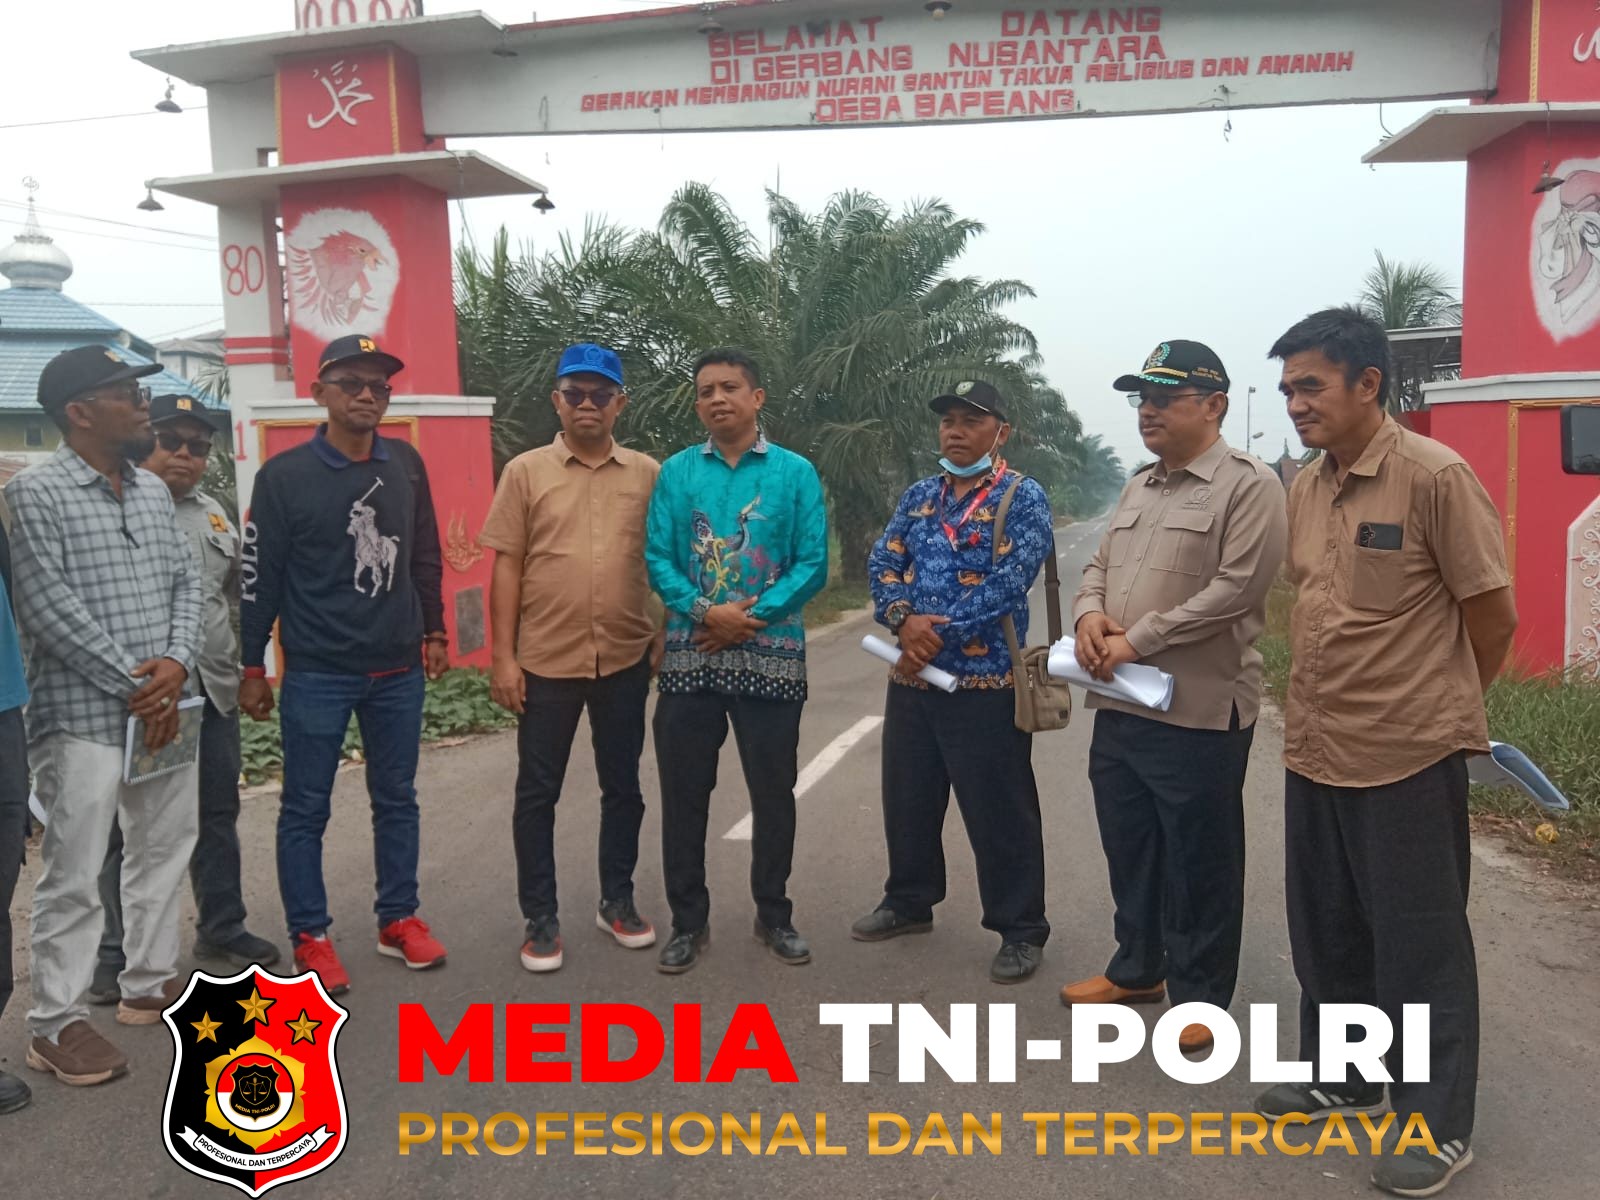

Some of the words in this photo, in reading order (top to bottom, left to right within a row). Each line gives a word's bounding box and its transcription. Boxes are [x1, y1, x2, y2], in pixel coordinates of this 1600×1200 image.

[708, 15, 883, 58] SELAMAT
[1002, 7, 1162, 37] DATANG
[581, 89, 678, 112] GERAKAN
[684, 80, 810, 105] MEMBANGUN
[816, 75, 896, 97] NURANI
[903, 69, 992, 91] SANTUN
[1085, 59, 1194, 82] RELIGIUS
[1201, 56, 1249, 77] DAN
[1257, 51, 1353, 75] AMANAH
[710, 59, 740, 84] DI
[753, 45, 913, 81] GERBANG
[948, 35, 1166, 67] NUSANTARA
[815, 95, 902, 122] DESA
[223, 244, 264, 296] 80
